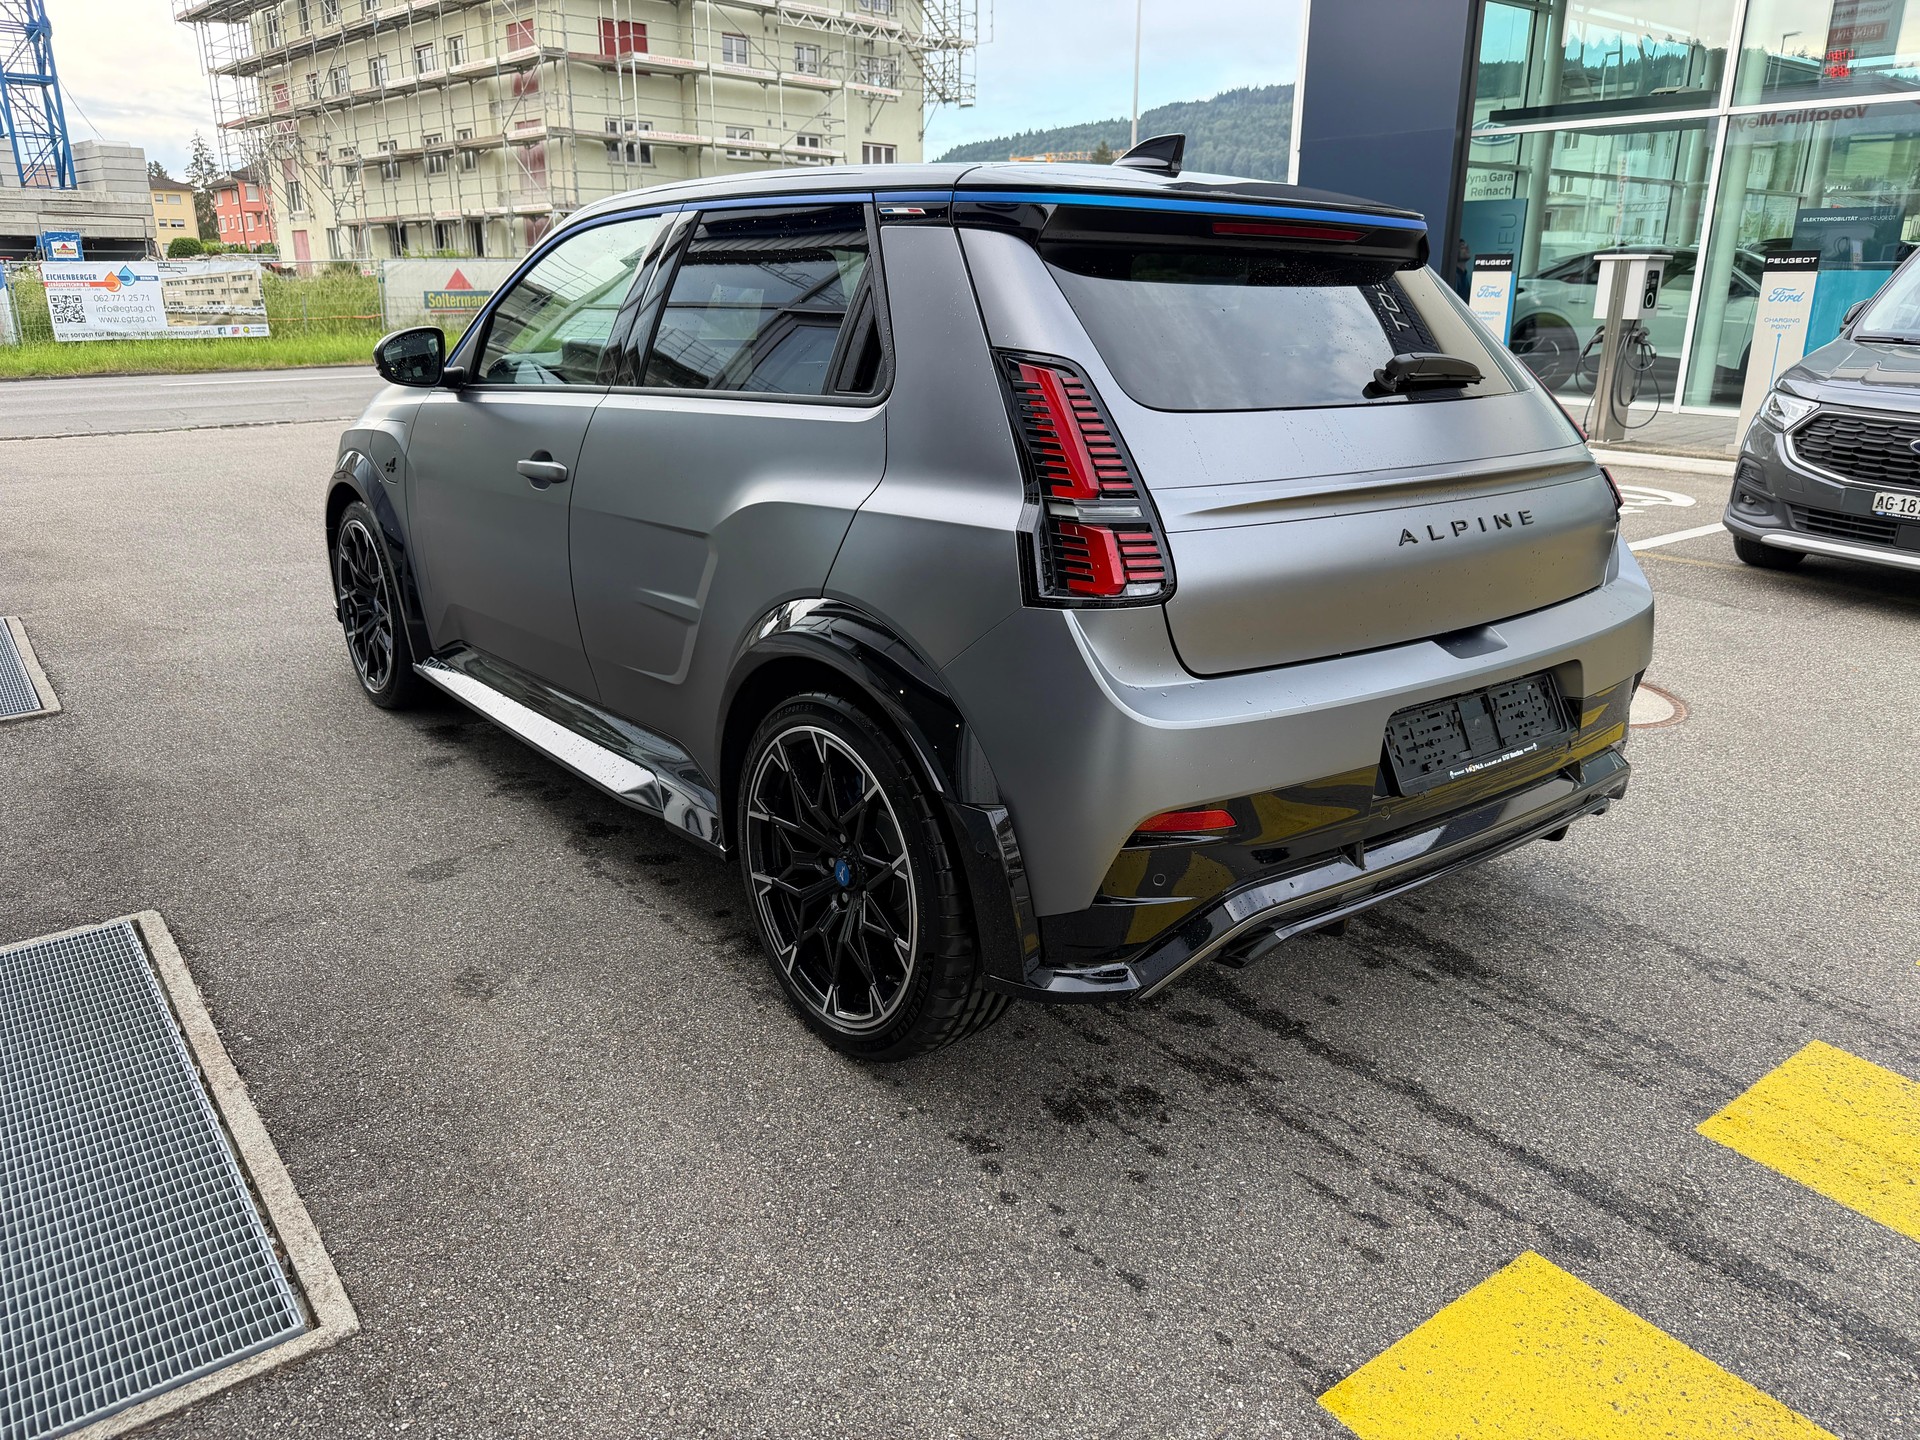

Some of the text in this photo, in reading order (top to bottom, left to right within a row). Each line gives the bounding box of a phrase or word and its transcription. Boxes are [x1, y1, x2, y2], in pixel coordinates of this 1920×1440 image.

[1470, 185, 1511, 197] Reinach
[1474, 258, 1512, 266] PEUGEOT
[1766, 256, 1818, 265] PEUGEOT
[45, 273, 98, 281] EICHENBERGER
[1476, 284, 1503, 299] Ford
[1767, 287, 1805, 303] Ford
[93, 294, 150, 302] 062 771 25 71
[95, 304, 156, 315] info@egtag.ch
[98, 315, 157, 325] www.egtag.ch
[1875, 496, 1920, 515] AG 18
[1398, 509, 1535, 547] ALPINE
